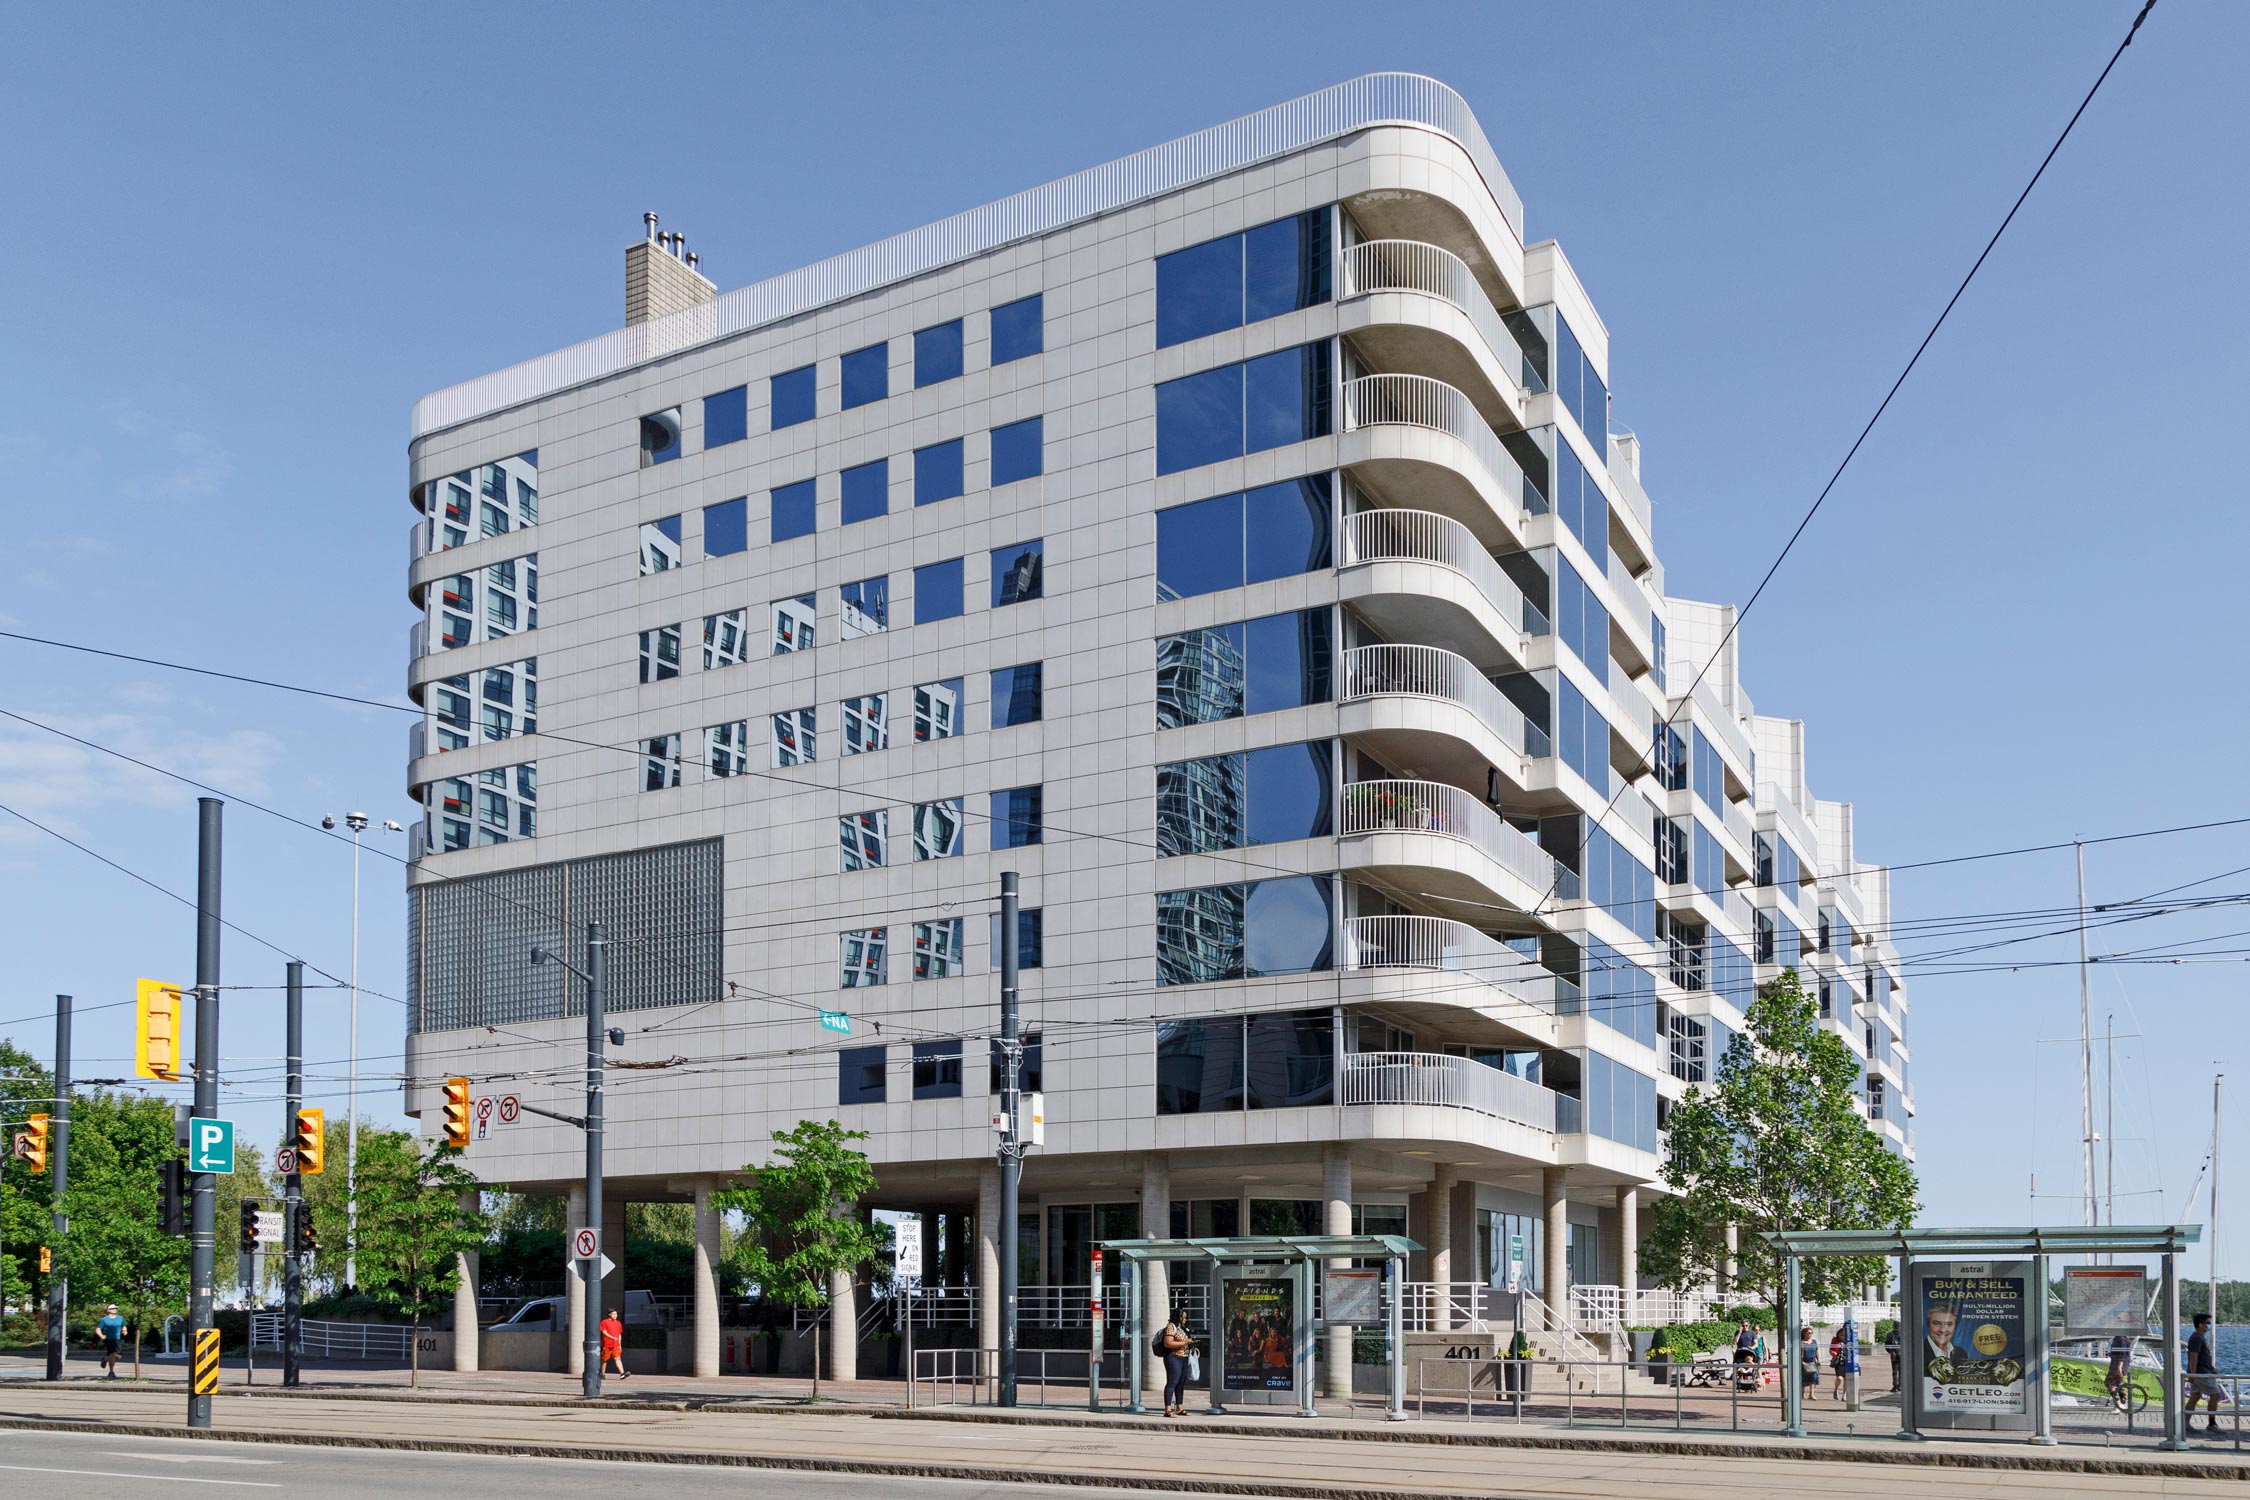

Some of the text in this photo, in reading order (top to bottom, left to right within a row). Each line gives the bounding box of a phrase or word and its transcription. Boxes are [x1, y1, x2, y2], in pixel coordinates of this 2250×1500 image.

[201, 1125, 223, 1152] P
[259, 1217, 282, 1226] RANSIT
[902, 1224, 917, 1232] STOP
[902, 1234, 917, 1242] HERE
[1935, 1280, 2013, 1289] BUY & SELL
[1928, 1290, 2018, 1299] GUARANTEED
[1978, 1333, 2001, 1342] FREE
[417, 1339, 437, 1351] 401
[1444, 1345, 1480, 1359] 401
